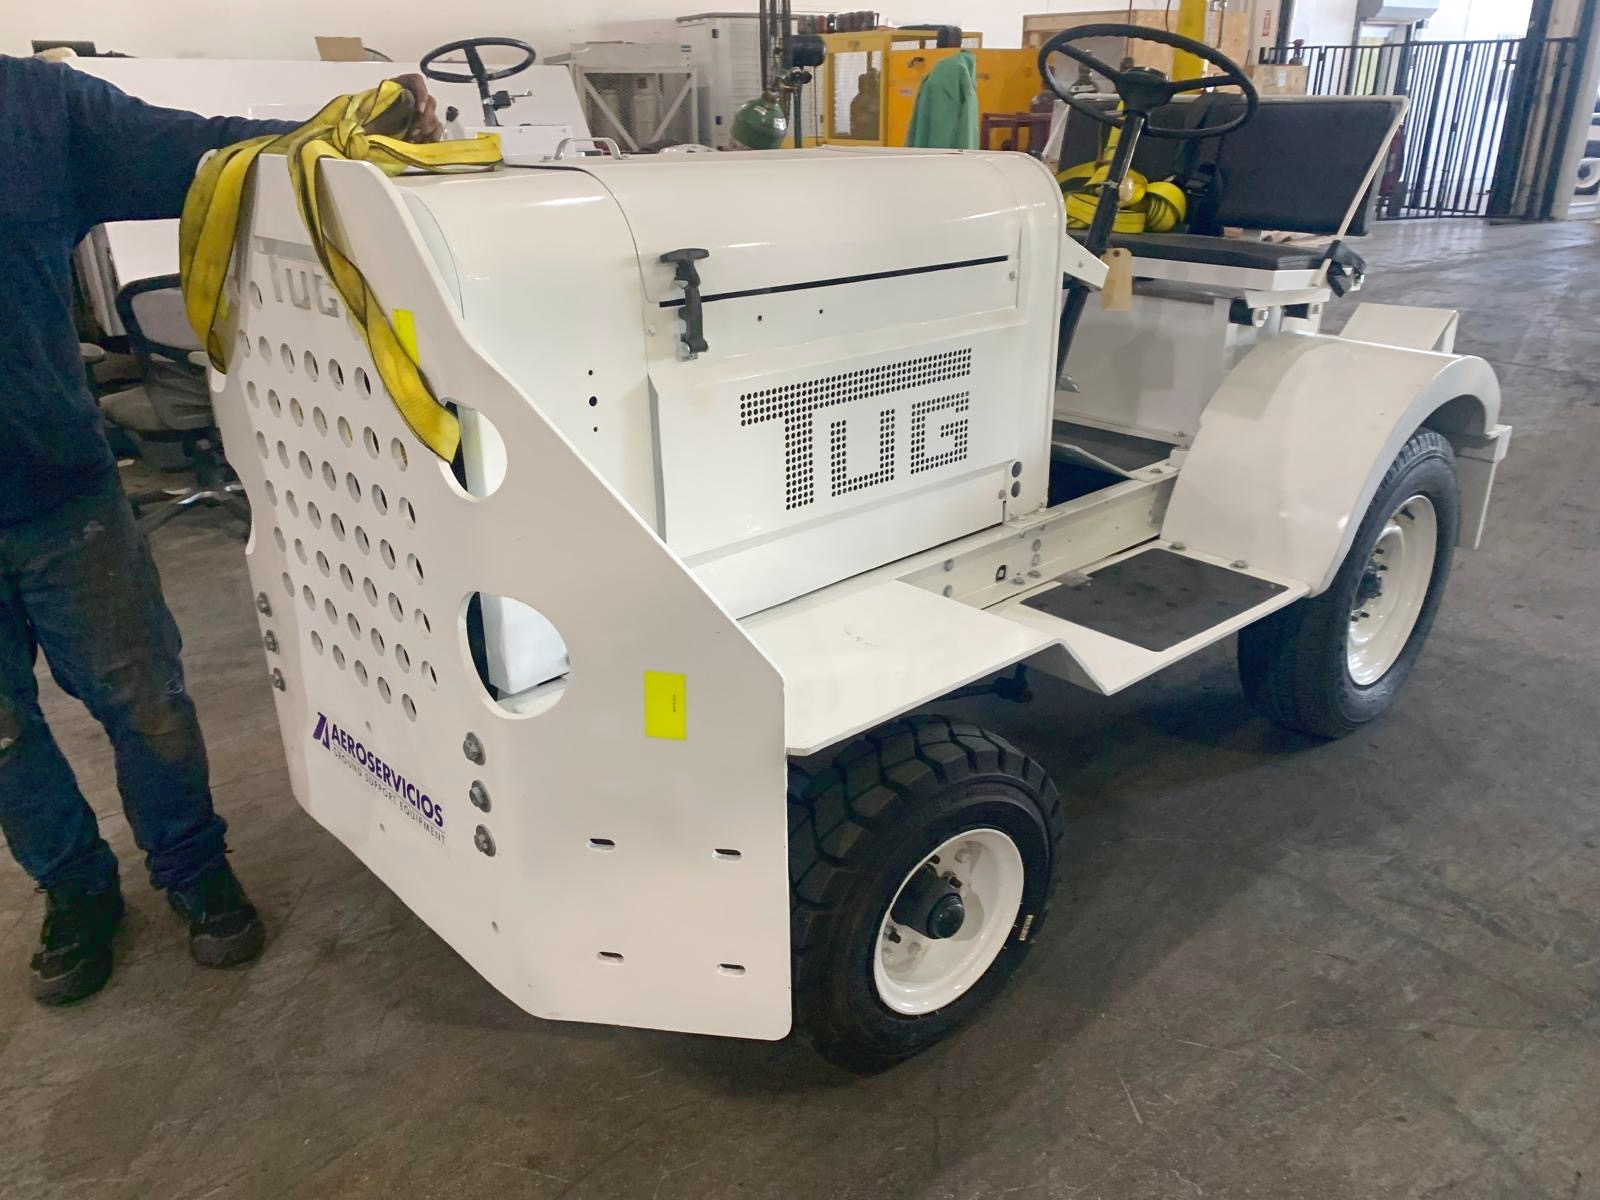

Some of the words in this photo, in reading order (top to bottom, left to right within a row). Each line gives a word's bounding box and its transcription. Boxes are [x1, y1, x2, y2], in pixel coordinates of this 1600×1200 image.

[253, 235, 341, 318] TUG
[740, 347, 972, 510] TUG
[331, 723, 444, 827] AEROSERVICIOS
[332, 746, 363, 777] GROUND
[364, 772, 397, 804] SUPPORT
[399, 801, 446, 843] EQUIPMENT
